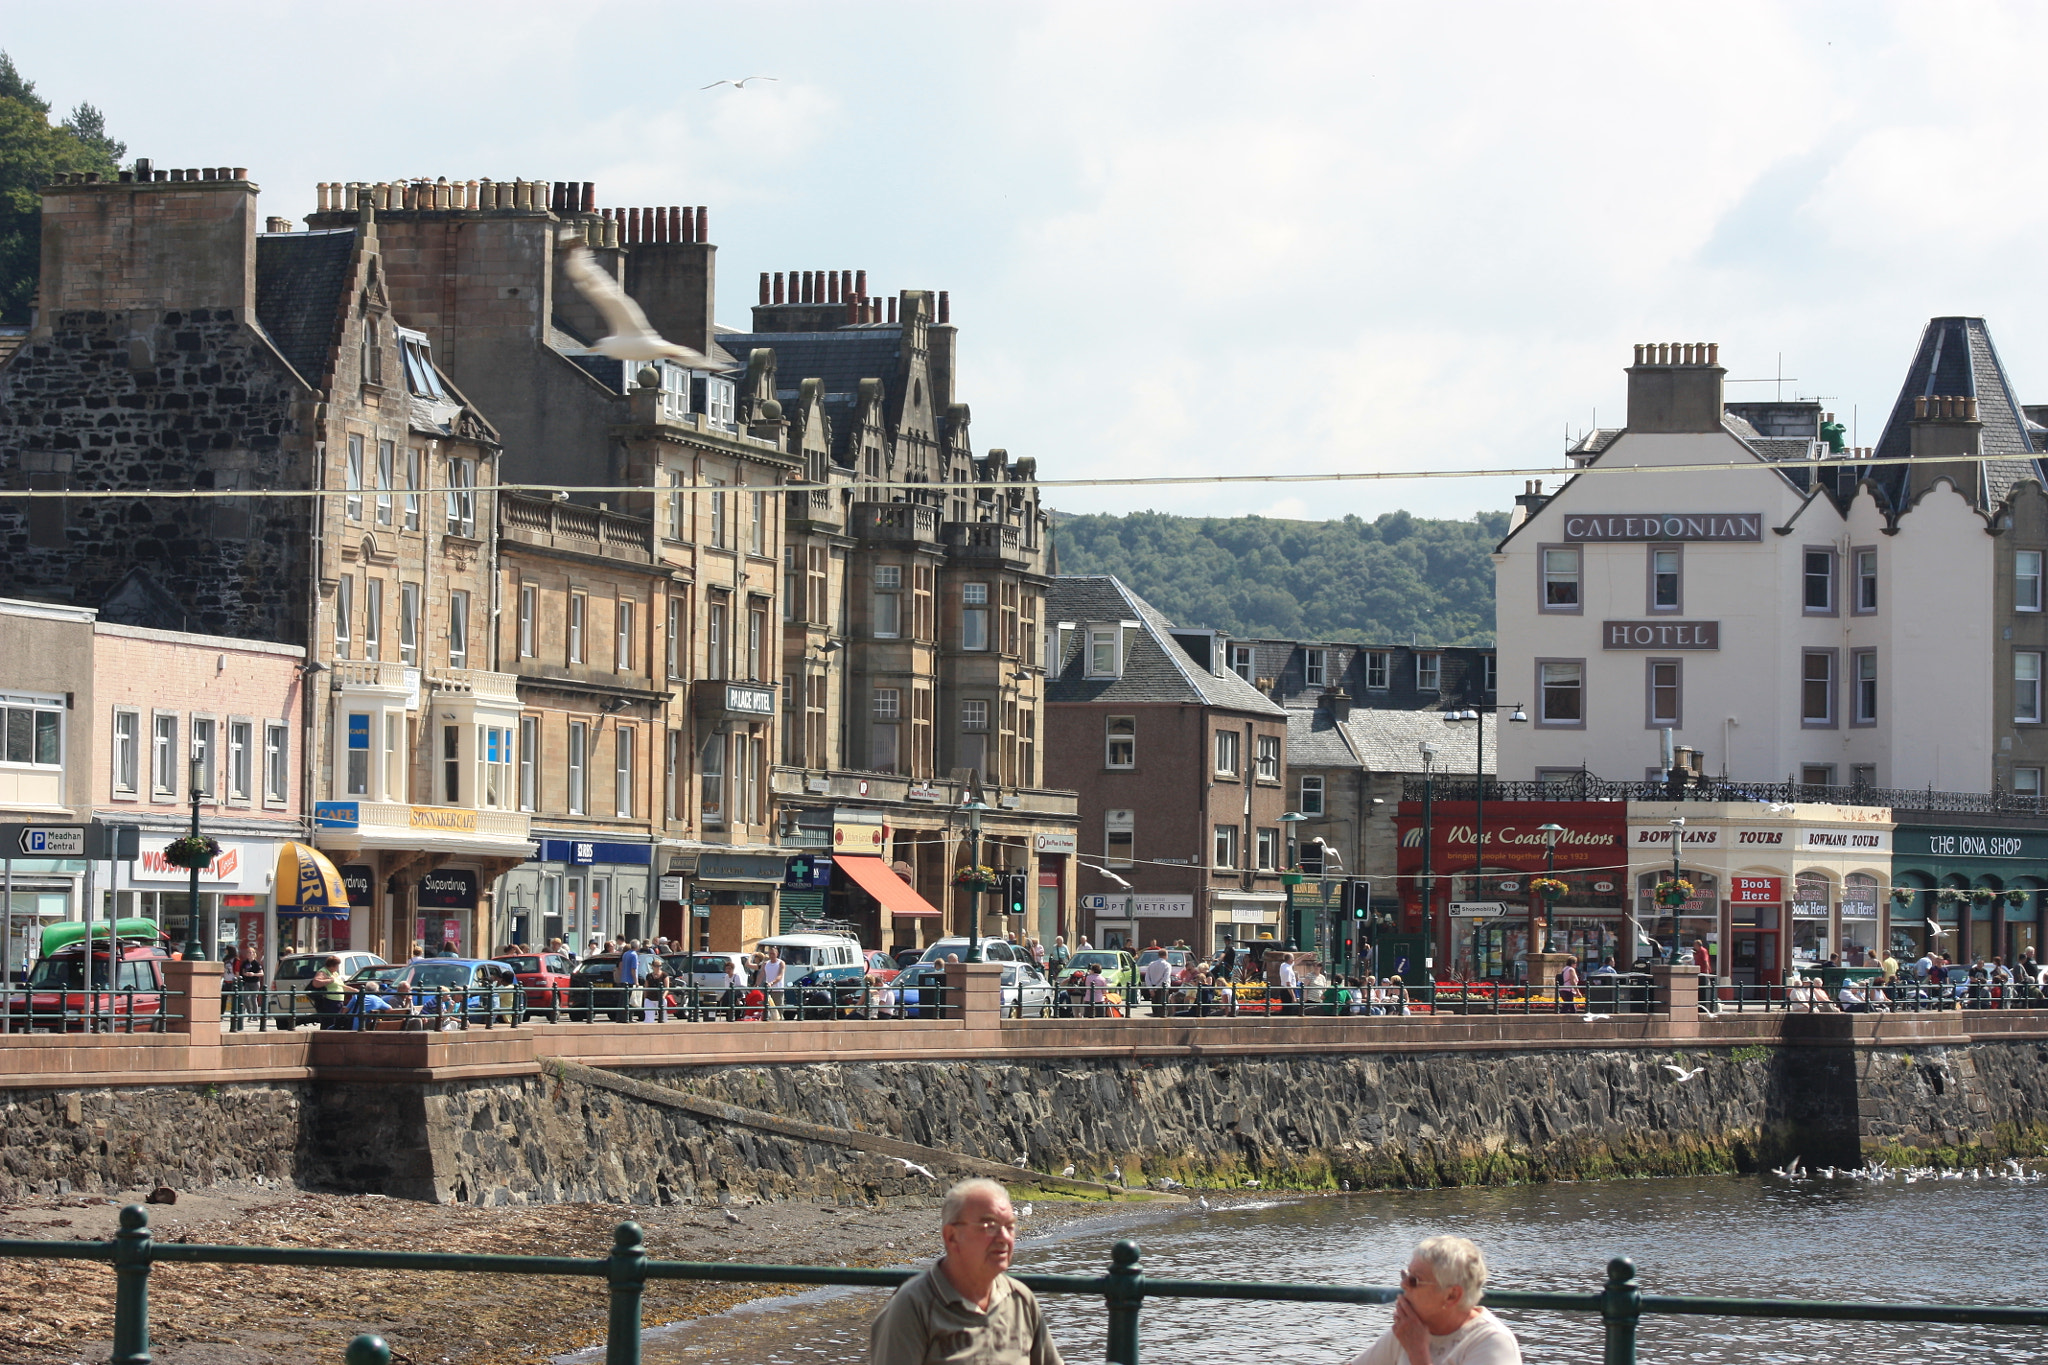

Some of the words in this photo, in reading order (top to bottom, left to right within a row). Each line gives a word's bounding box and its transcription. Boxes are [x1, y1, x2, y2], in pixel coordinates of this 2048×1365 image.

[1567, 517, 1758, 537] CALEDONIAN
[1611, 625, 1709, 645] HOTEL
[730, 689, 752, 709] PALACE
[753, 692, 771, 711] HOTEL
[317, 808, 356, 820] CAFE
[456, 812, 475, 829] CAFE
[35, 833, 44, 849] P
[48, 832, 82, 840] Meadhan
[1447, 825, 1492, 845] West
[1498, 826, 1549, 845] Coast
[1555, 827, 1614, 846] Motors
[1739, 831, 1783, 844] TOURS
[1808, 833, 1848, 846] BOWMANS
[1852, 834, 1880, 847] TOURS
[47, 842, 76, 851] Central
[582, 843, 594, 858] RBS
[1929, 835, 1955, 854] THE
[1959, 836, 1987, 855] IONA
[1990, 837, 2022, 856] SHOP
[1508, 851, 1540, 861] together
[1552, 852, 1568, 861] ince
[1570, 852, 1589, 861] 1923
[425, 874, 466, 896] Superdrug
[1740, 879, 1771, 889] Book
[1741, 890, 1770, 900] Here
[302, 905, 322, 913] CAFE
[1096, 898, 1103, 907] P
[1105, 903, 1187, 912] OPTMETRIST
[1461, 905, 1498, 913] Shopmobility
[1810, 901, 1828, 915] Here
